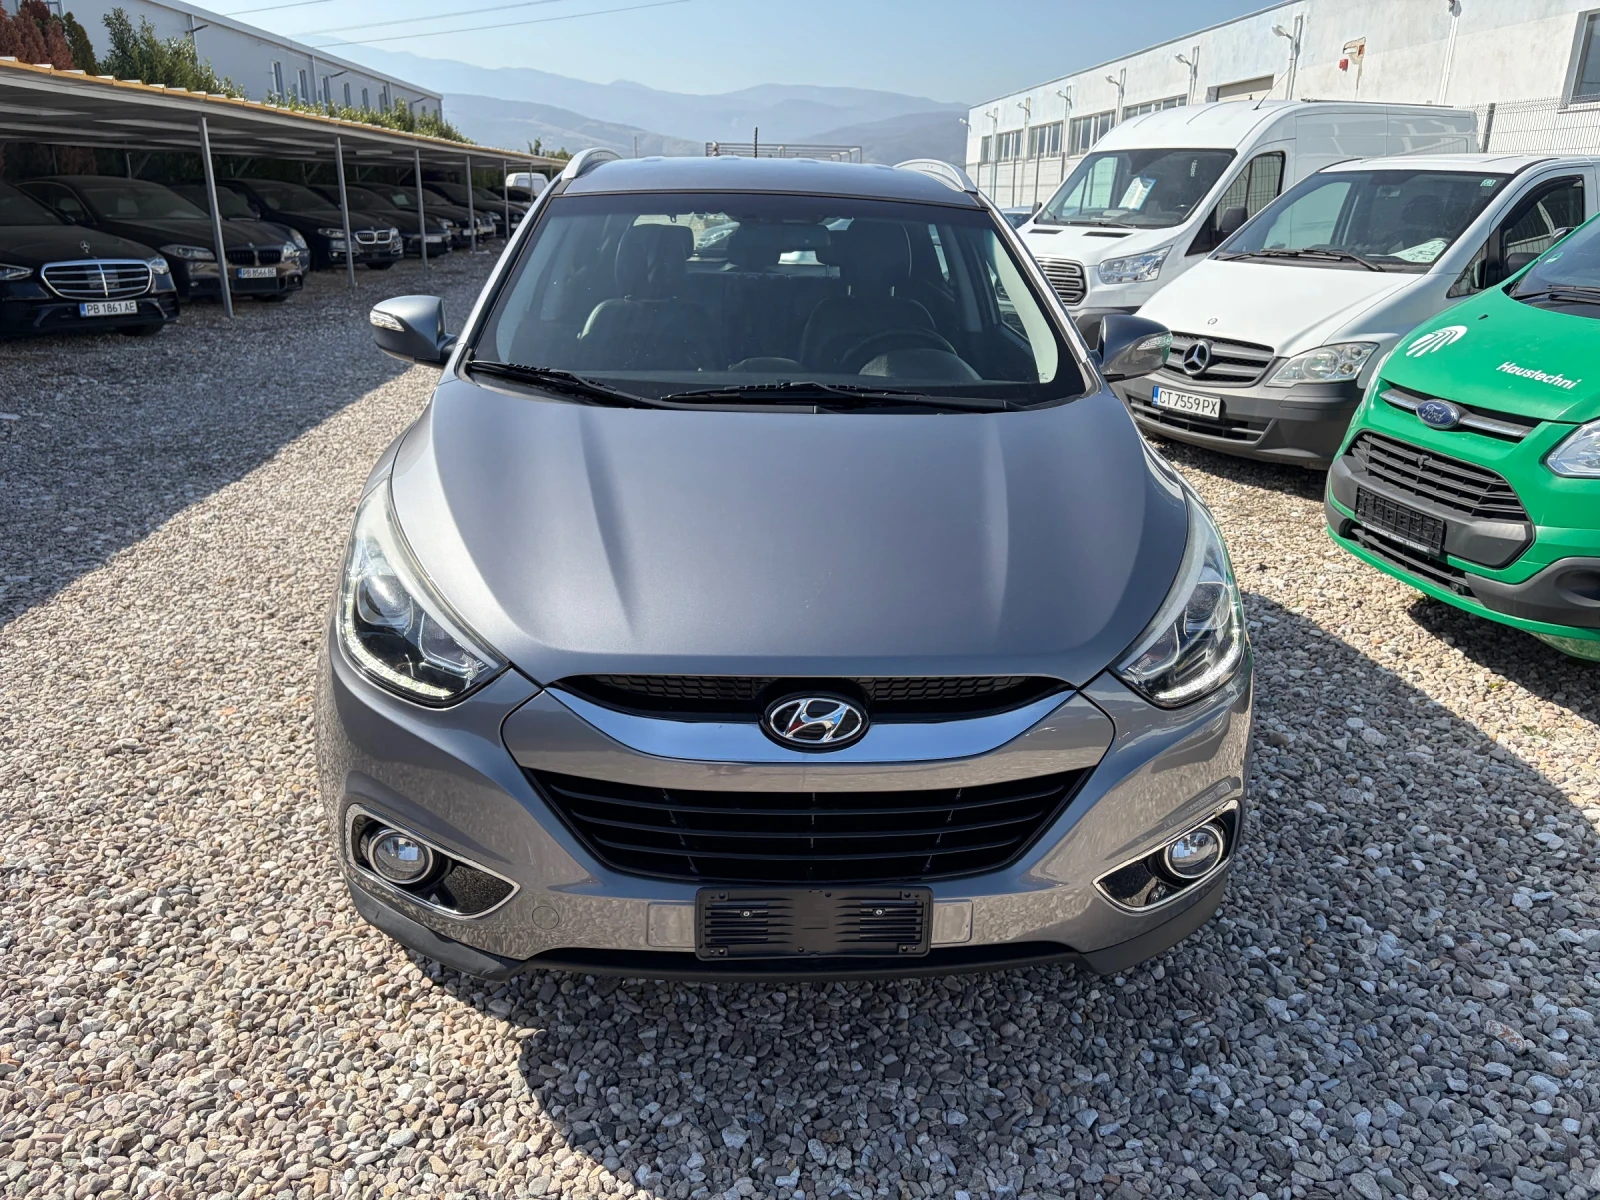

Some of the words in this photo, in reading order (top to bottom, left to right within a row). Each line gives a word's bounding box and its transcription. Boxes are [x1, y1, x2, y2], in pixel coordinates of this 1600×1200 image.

[86, 304, 100, 314] PB
[102, 303, 123, 313] 1861
[125, 301, 136, 312] AE
[1495, 360, 1582, 390] Haustechni
[1421, 403, 1447, 423] Ford
